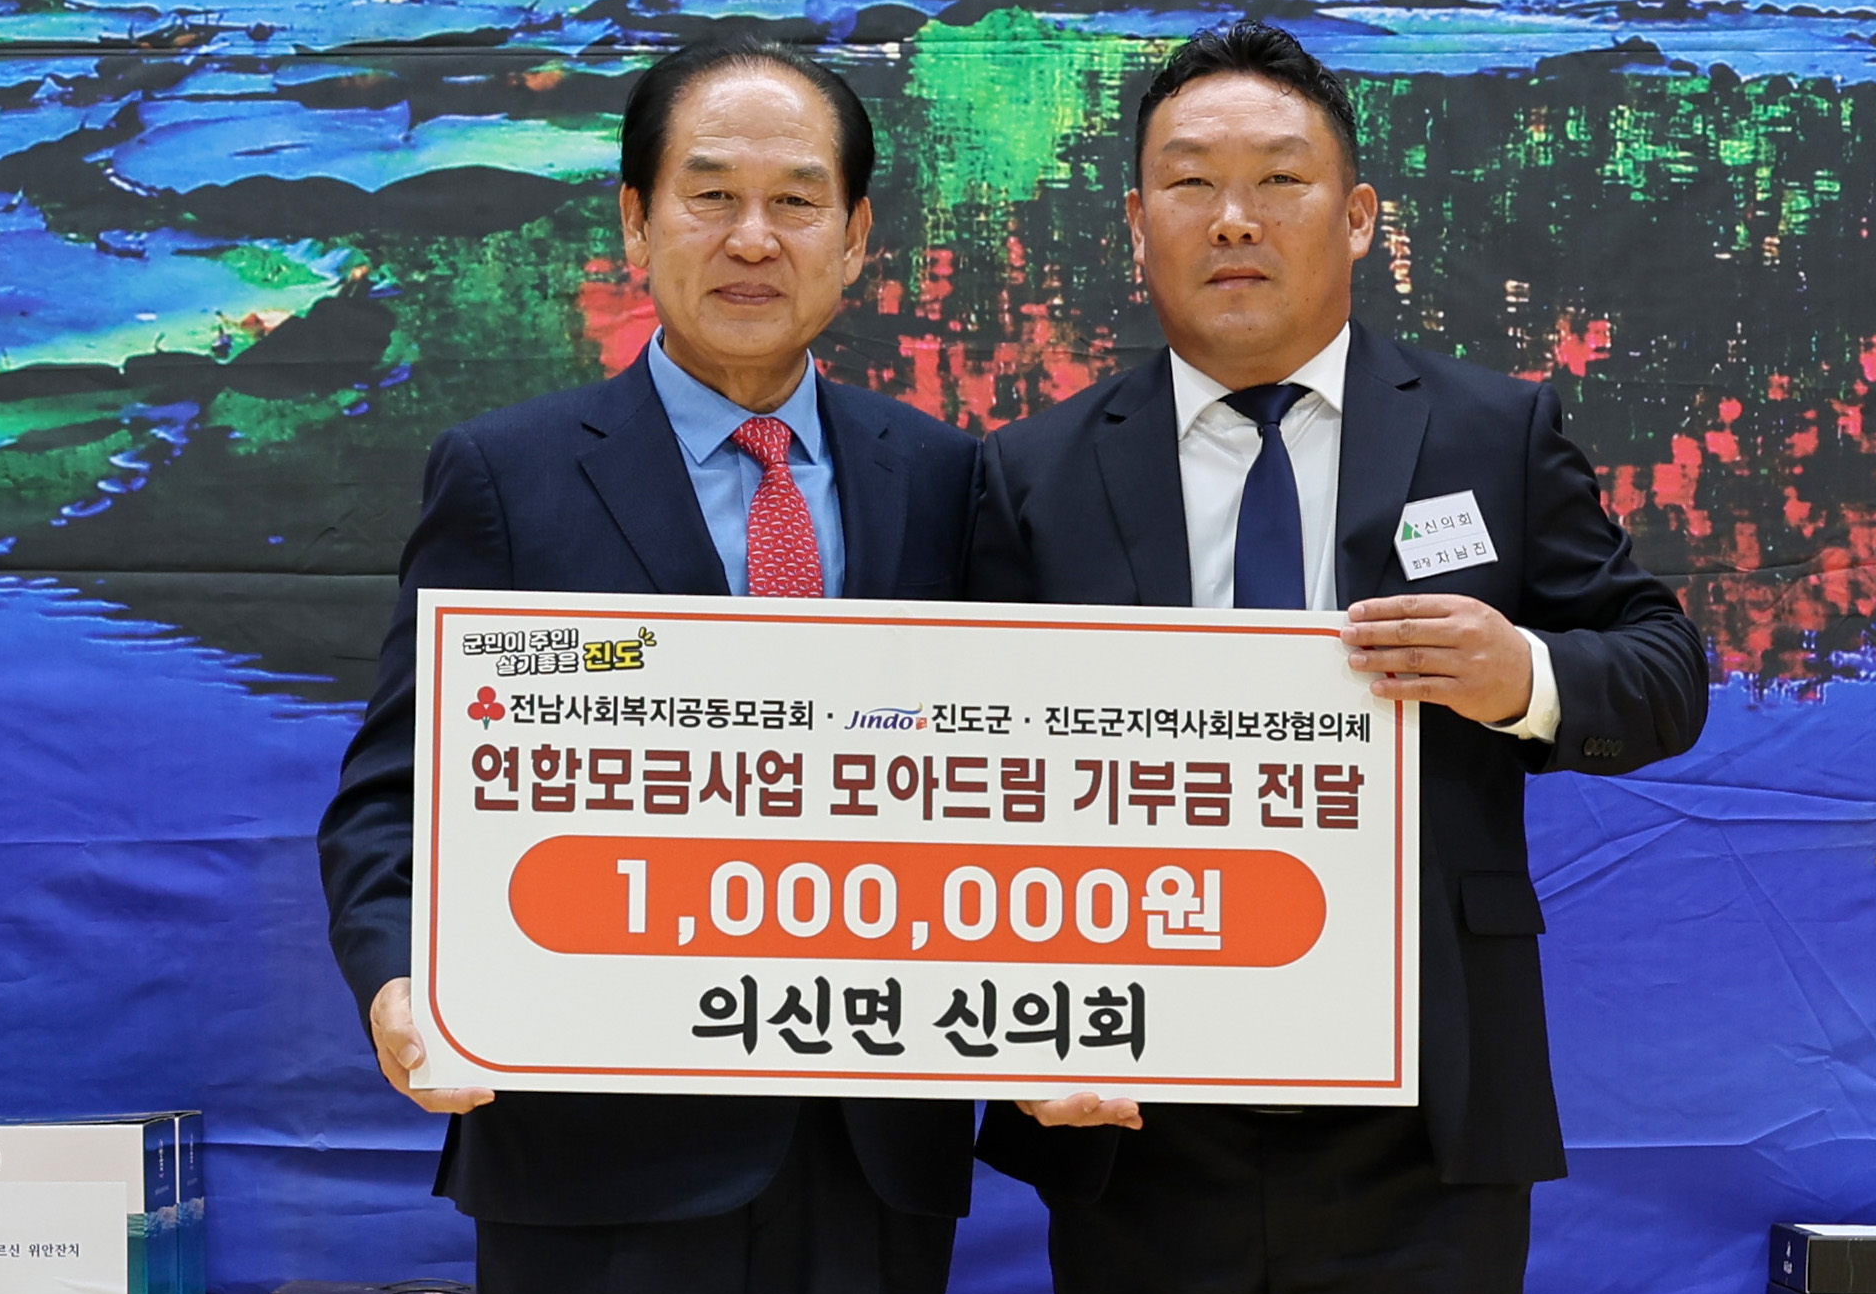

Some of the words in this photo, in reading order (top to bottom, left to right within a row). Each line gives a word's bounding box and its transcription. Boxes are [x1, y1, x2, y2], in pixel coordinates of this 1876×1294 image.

[462, 631, 525, 655] 군민이
[529, 628, 579, 651] 주인!
[495, 652, 579, 677] 살기좋은
[583, 640, 645, 672] 진도
[510, 693, 814, 730] 전남사회복지공동모금회
[844, 704, 916, 731] Jindo
[931, 704, 1012, 735] 진도군
[1044, 707, 1372, 743] 진도군지역사회보장협의체
[471, 743, 804, 819] 연합모금사업
[829, 753, 1046, 824] 모아드림
[1073, 758, 1233, 827] 기부금
[1257, 762, 1365, 830] 전달
[616, 857, 1224, 953] 1,000,000원
[691, 974, 904, 1058] 의신면
[933, 978, 1148, 1062] 신의회
[27, 1242, 80, 1259] 위안잔치
